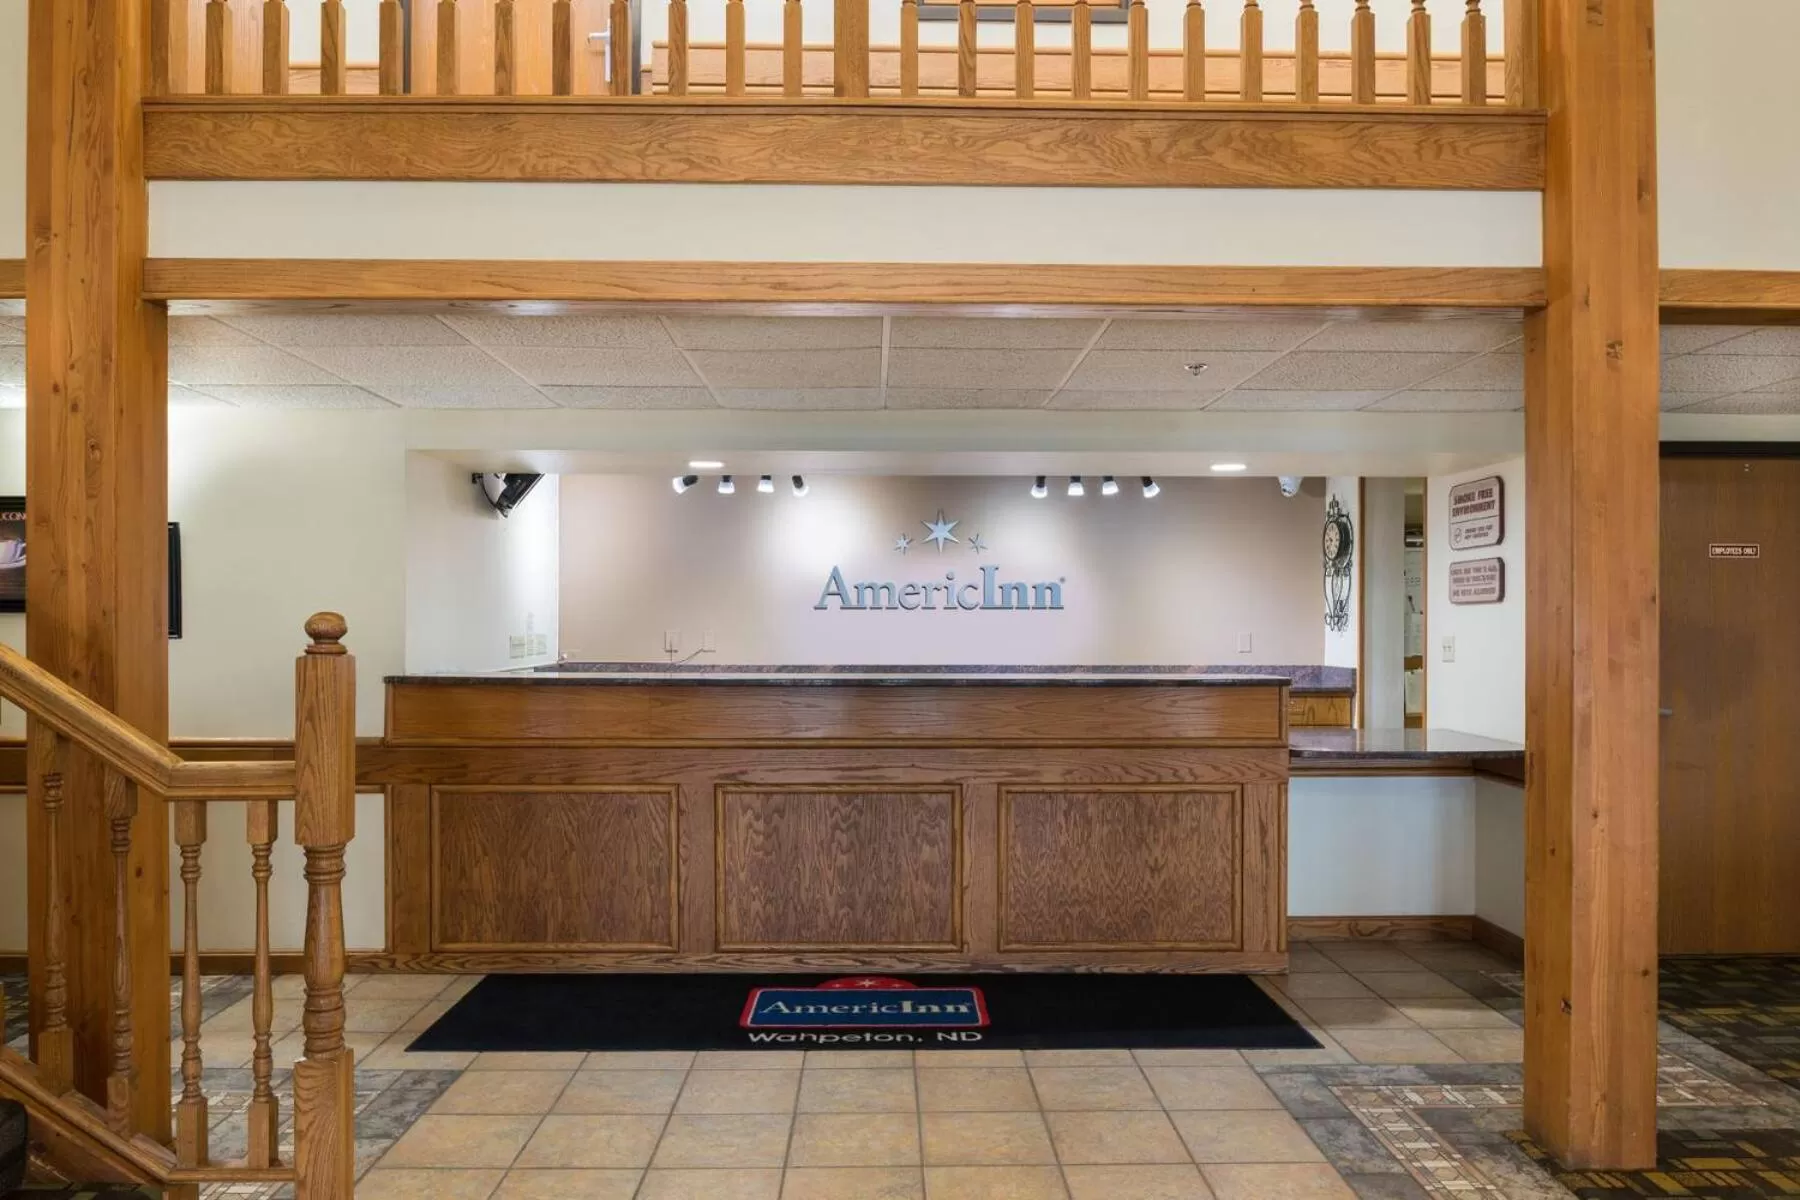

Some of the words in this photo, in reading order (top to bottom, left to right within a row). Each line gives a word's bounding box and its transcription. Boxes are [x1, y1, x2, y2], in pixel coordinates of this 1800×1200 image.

[813, 565, 1065, 610] AmericInn
[759, 1000, 970, 1014] AmericInn
[936, 1032, 983, 1042] ND
